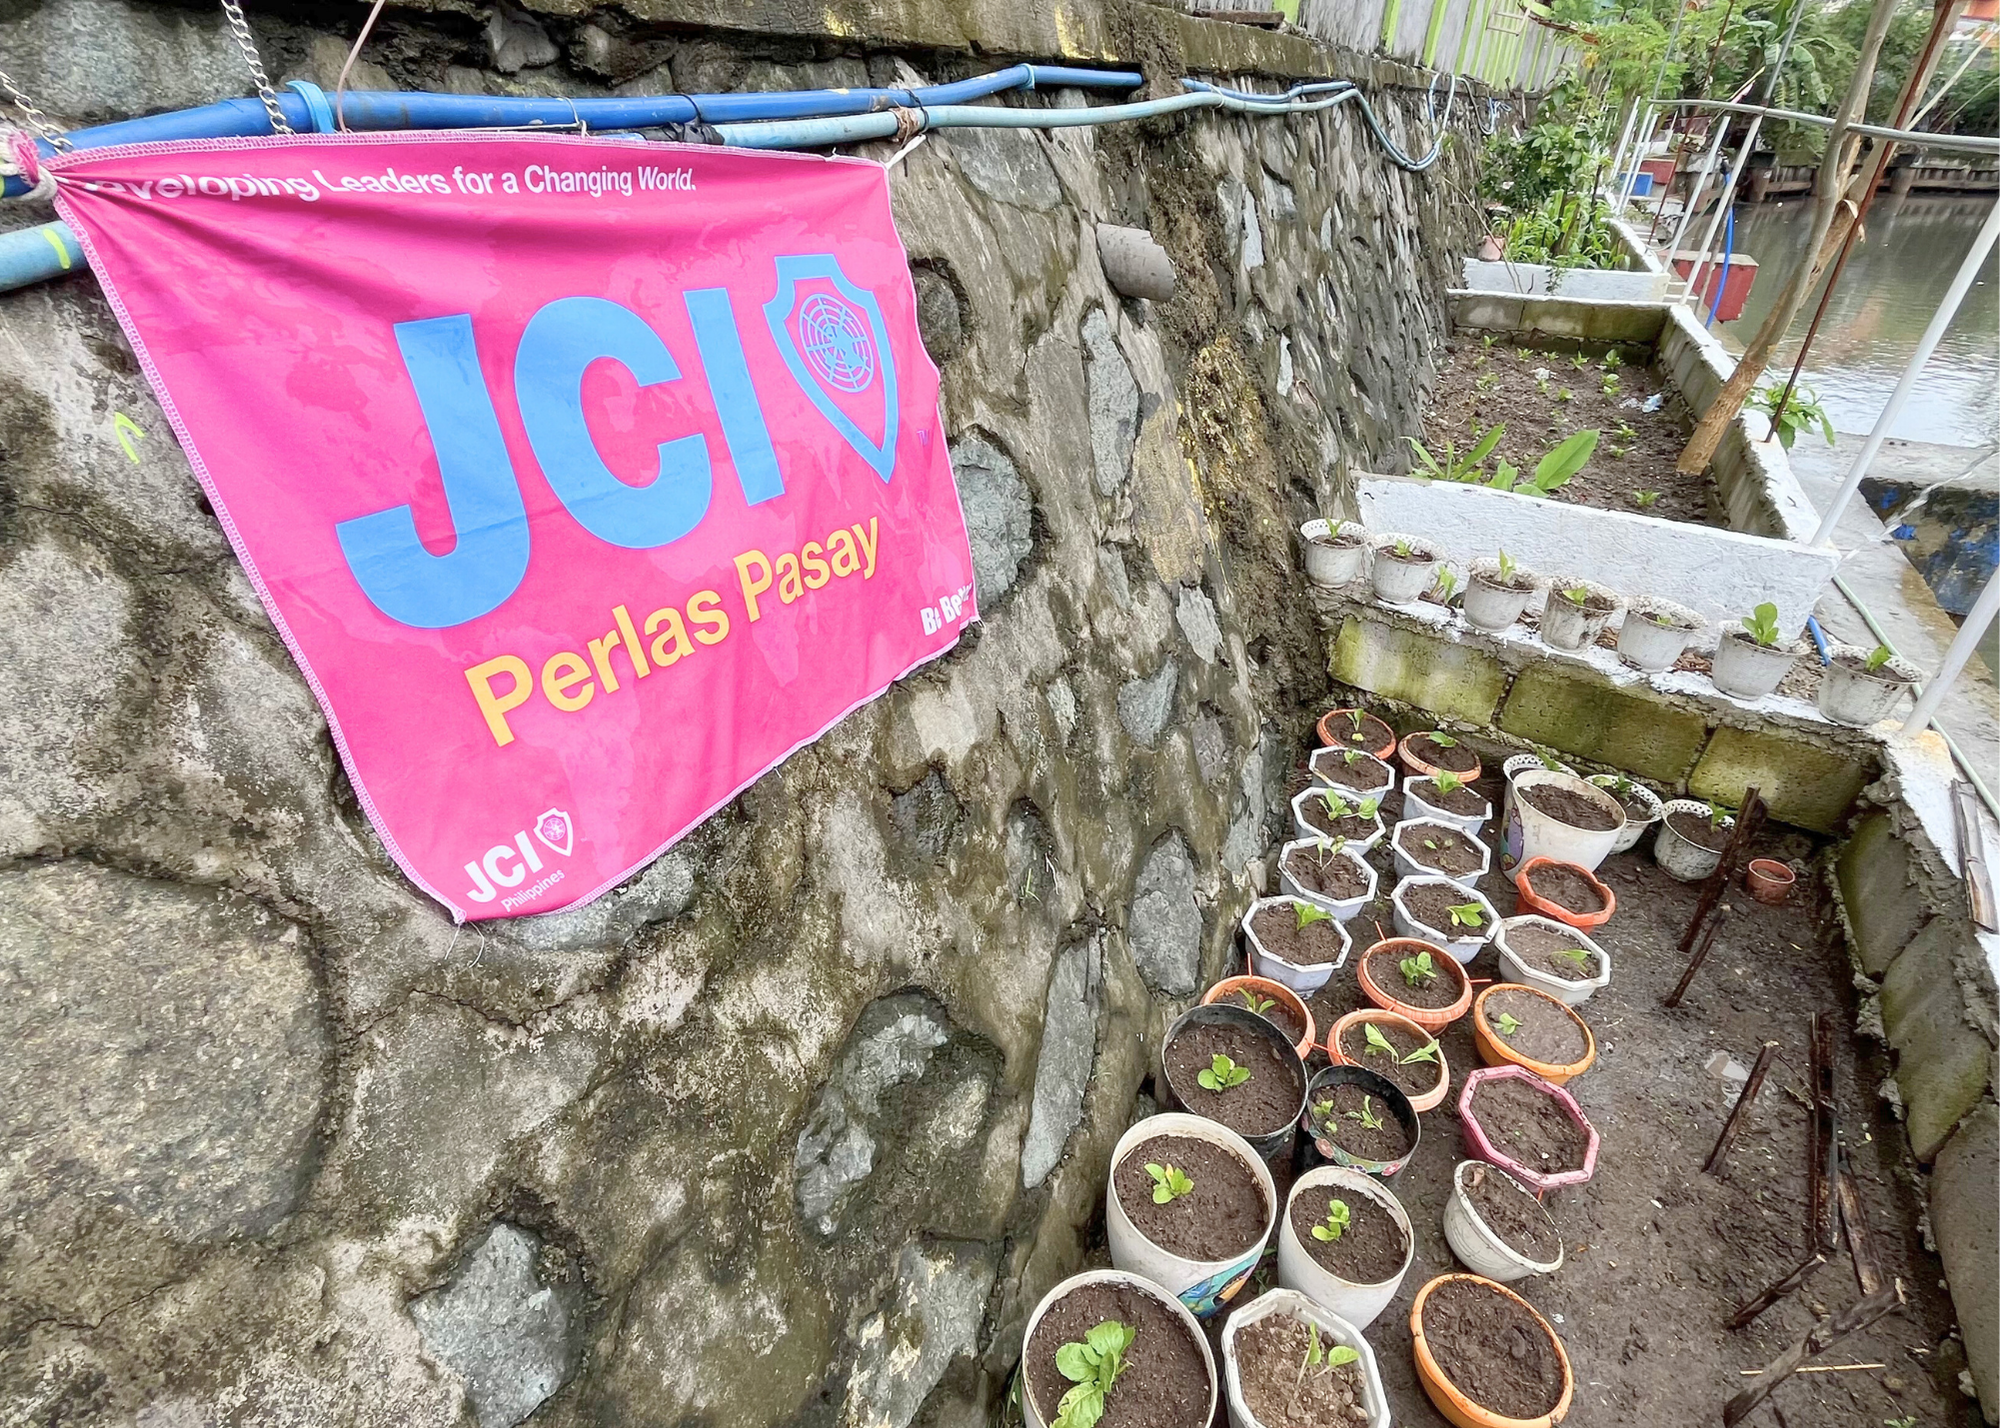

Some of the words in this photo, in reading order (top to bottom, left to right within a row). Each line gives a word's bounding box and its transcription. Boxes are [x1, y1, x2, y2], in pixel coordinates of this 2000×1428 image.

[54, 170, 320, 202] veloping
[312, 169, 452, 194] Leaders
[452, 166, 494, 194] for
[501, 172, 520, 194] a
[524, 164, 634, 198] Changing
[637, 166, 697, 191] World.
[335, 286, 786, 629] JCI
[464, 590, 730, 747] Perlas
[733, 517, 878, 623] Pasay
[463, 830, 544, 903] JCI
[500, 869, 565, 913] Philippines
